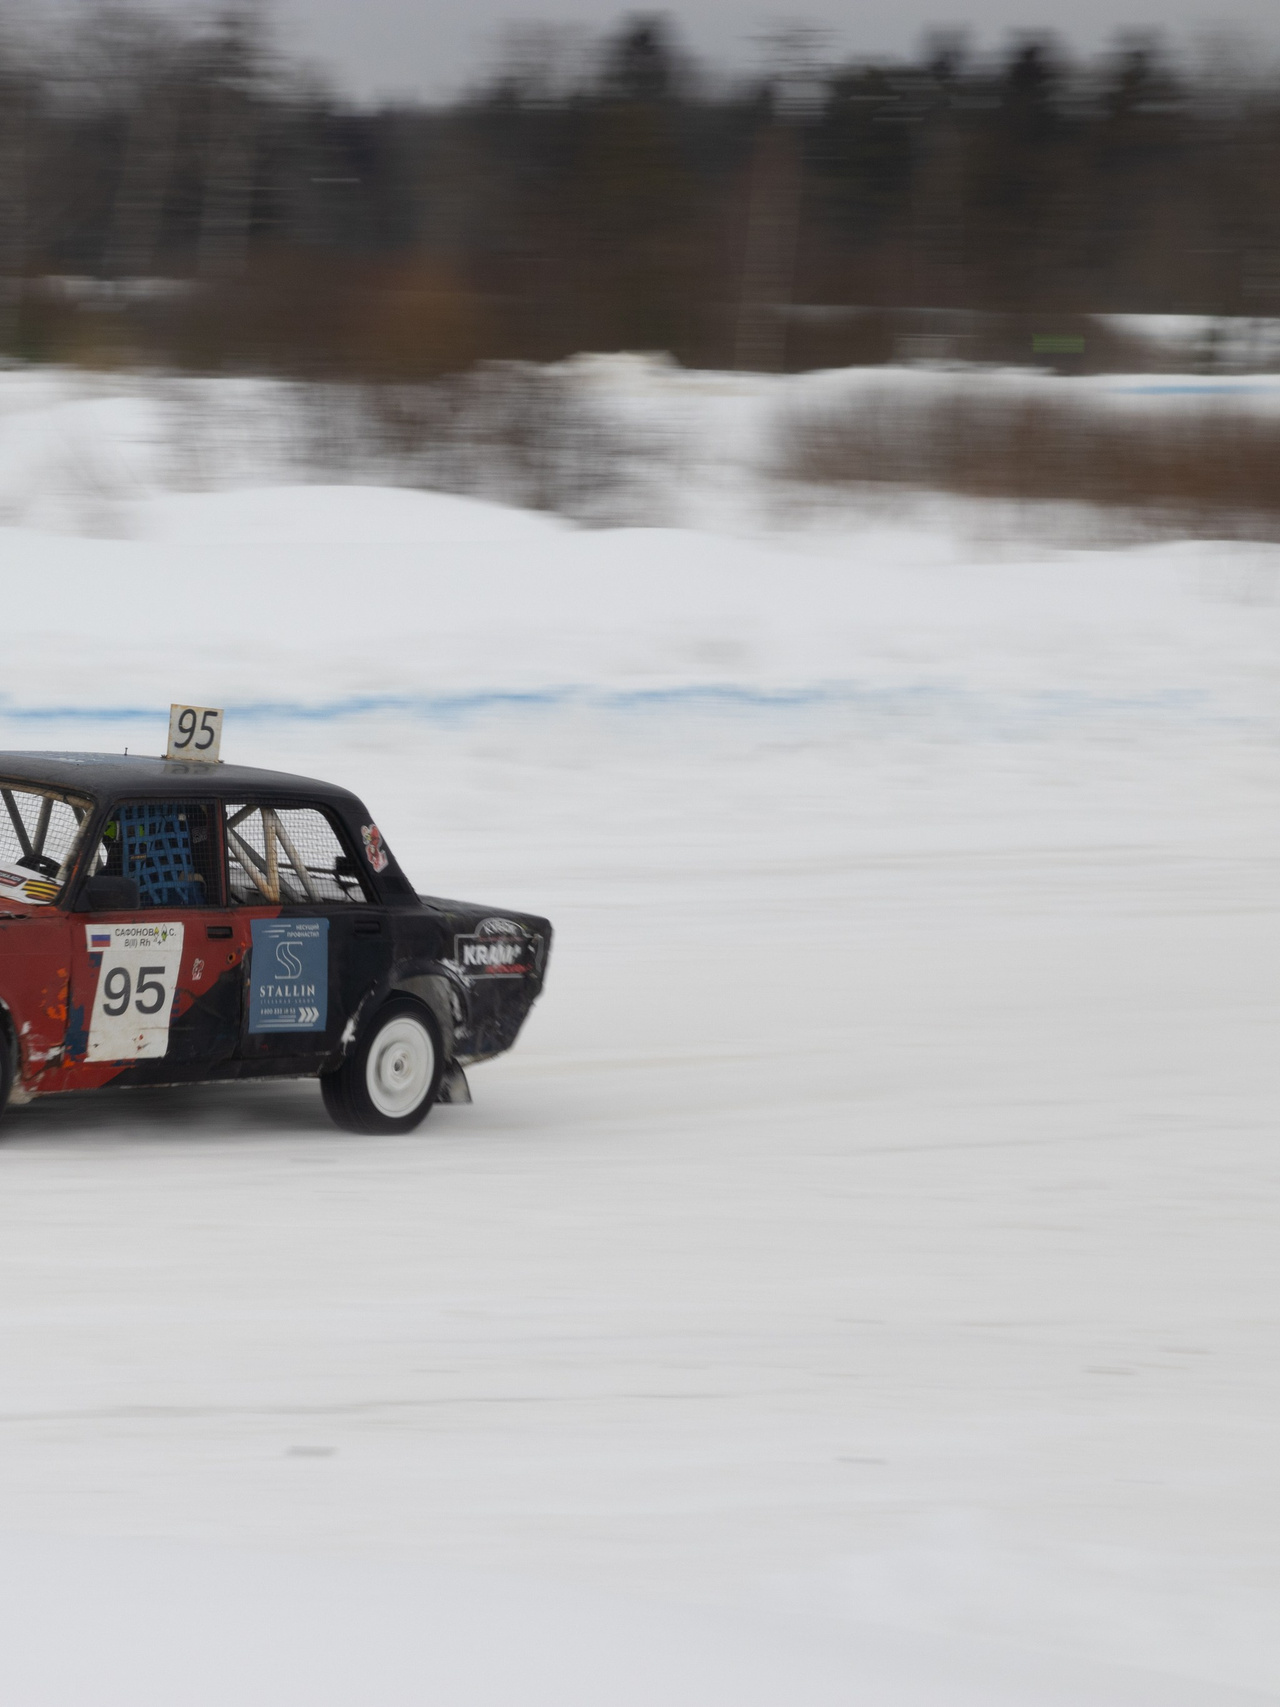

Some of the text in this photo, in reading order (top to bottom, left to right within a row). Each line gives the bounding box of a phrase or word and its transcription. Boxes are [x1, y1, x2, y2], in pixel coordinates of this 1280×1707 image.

[173, 708, 219, 751] 95
[102, 966, 166, 1017] 95
[259, 984, 316, 998] STALLIN
